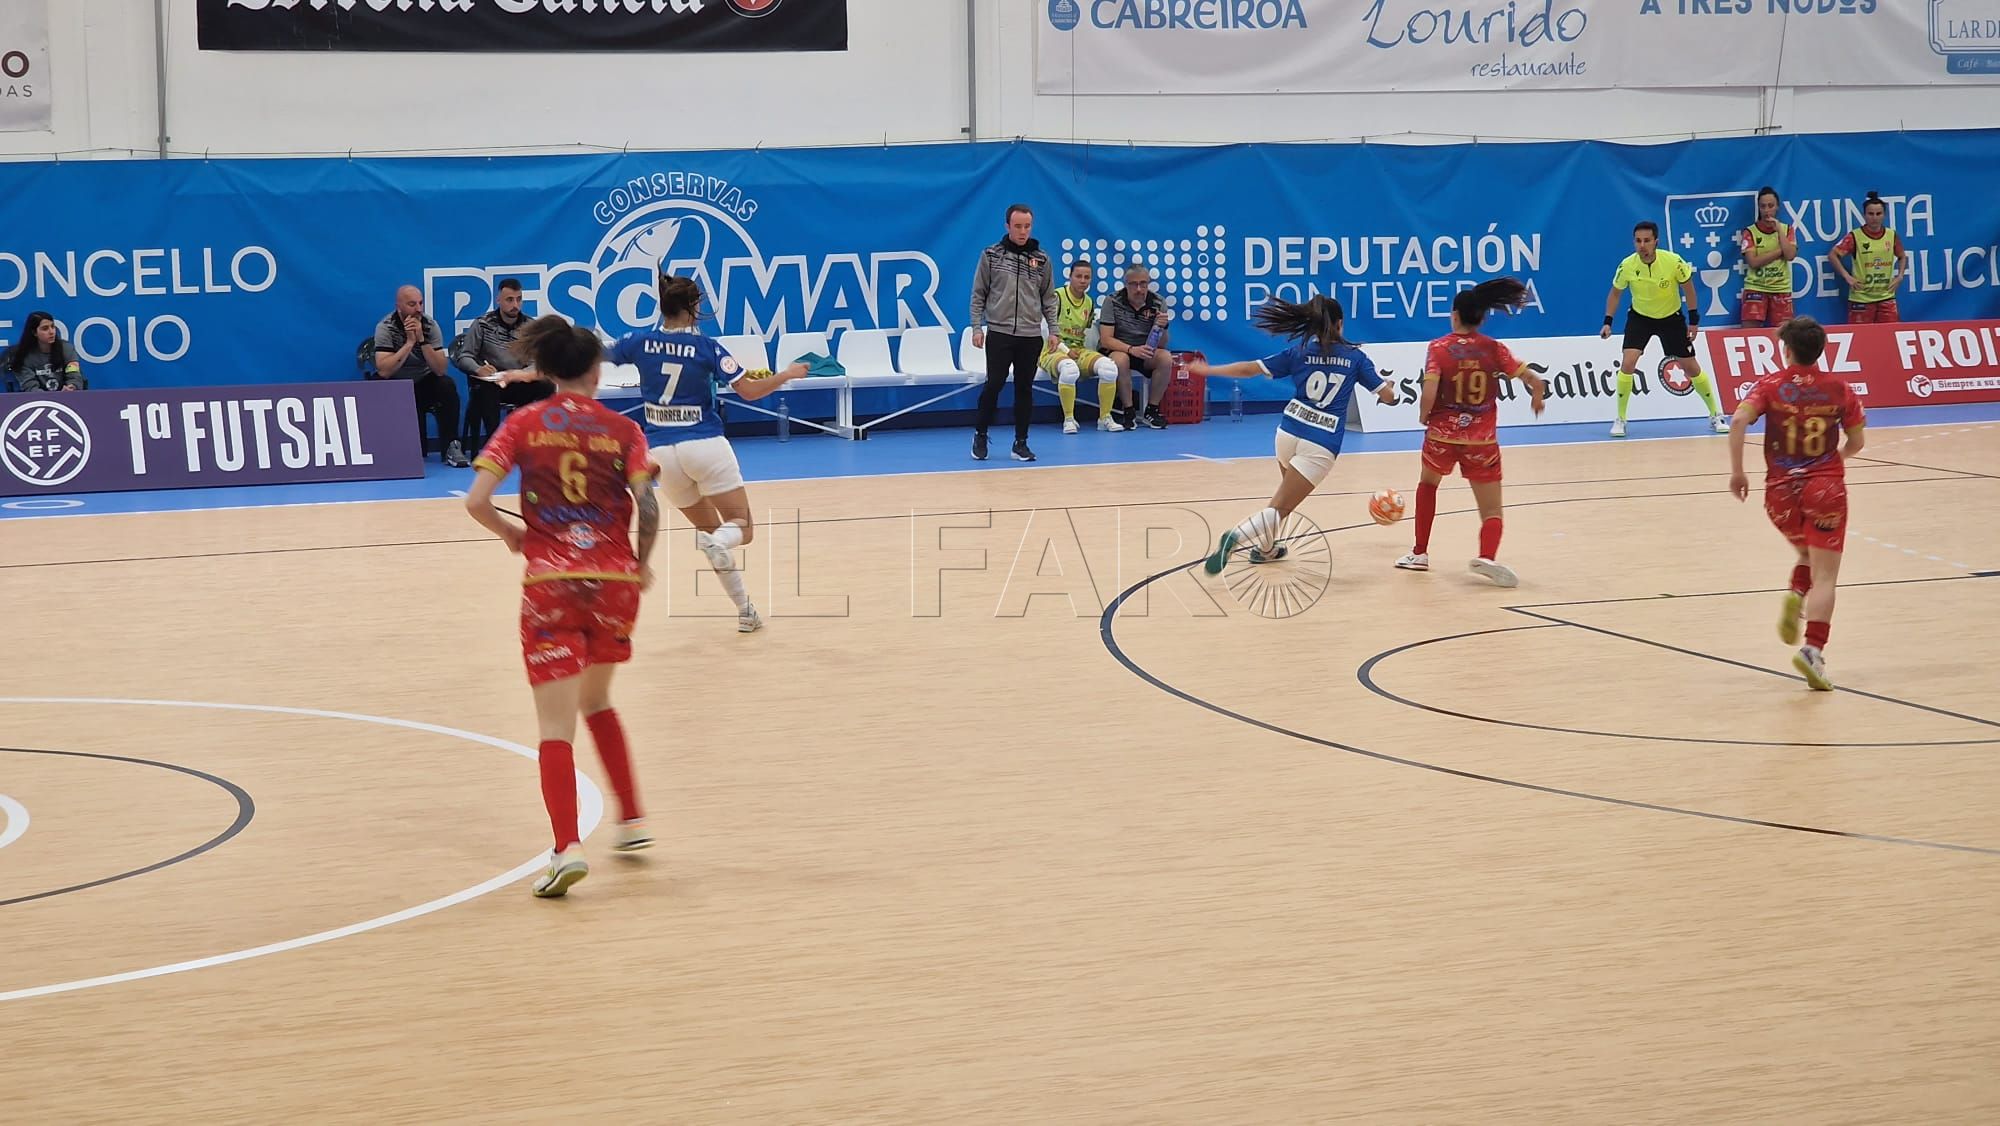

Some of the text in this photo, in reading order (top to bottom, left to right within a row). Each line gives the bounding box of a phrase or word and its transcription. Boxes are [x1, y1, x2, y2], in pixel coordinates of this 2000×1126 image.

[1362, 0, 1588, 49] Lourido
[1640, 0, 1661, 15] A
[1677, 0, 1752, 15] TRES
[1948, 20, 2000, 39] LAR D
[1470, 52, 1587, 78] restaurante
[0, 84, 32, 97] AS
[593, 172, 759, 225] CONSERVAS
[1783, 194, 1935, 243] XUNTA
[1244, 223, 1543, 277] DEPUTACIÓN
[1893, 245, 2000, 293] ALICI
[1244, 277, 1545, 321] POTEVEA
[53, 314, 191, 364] OIO
[644, 339, 696, 358] LYDIA
[1723, 332, 1862, 377] FRZ
[658, 362, 684, 405] 7
[1304, 356, 1352, 368] JULIANA
[1523, 360, 1651, 400] Galica
[1451, 370, 1488, 405] 19
[1938, 380, 1974, 389] Siempre
[182, 396, 374, 472] FUTSAL
[1781, 415, 1828, 457] 18
[558, 450, 589, 505] 6
